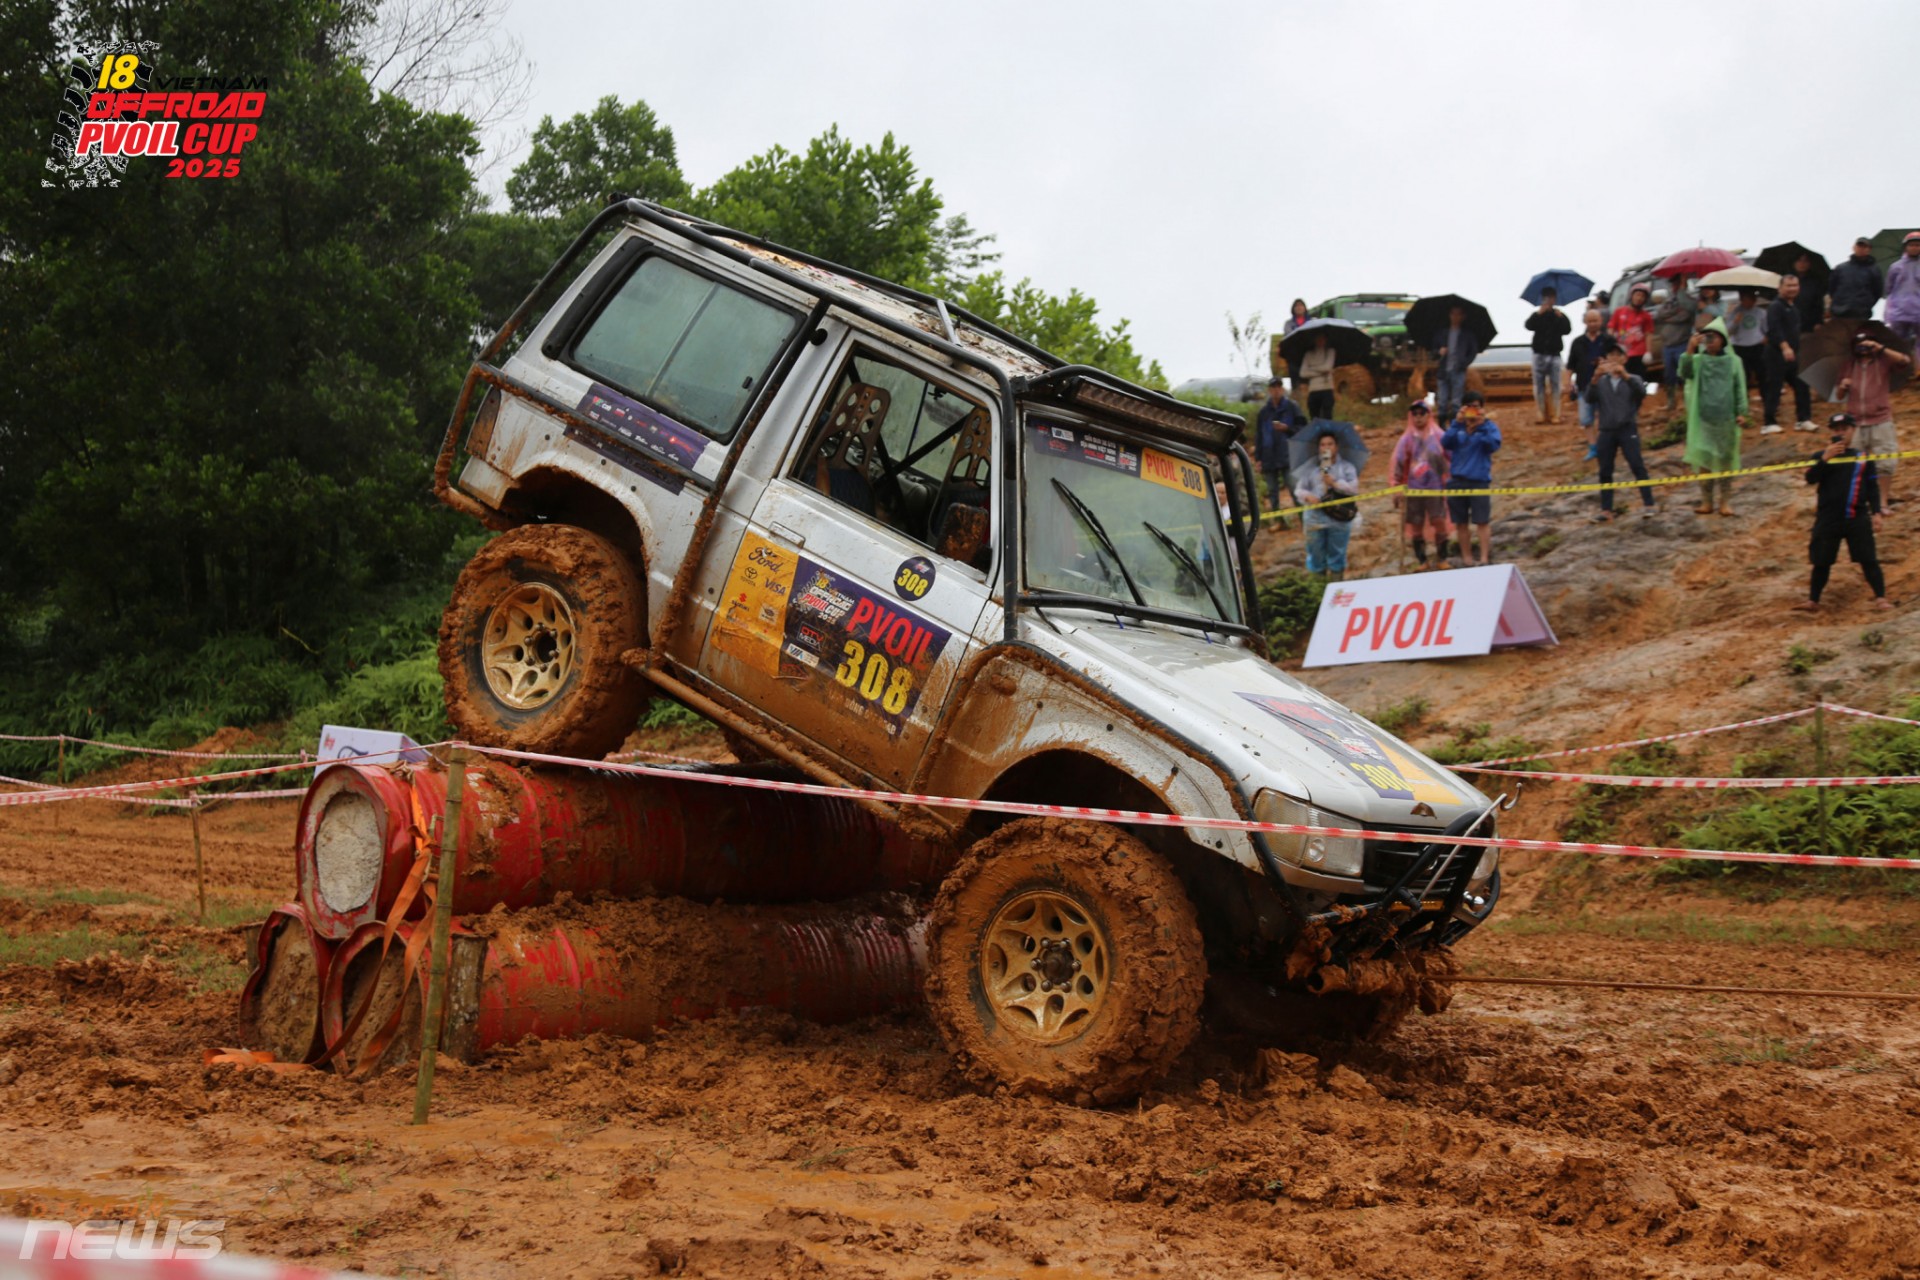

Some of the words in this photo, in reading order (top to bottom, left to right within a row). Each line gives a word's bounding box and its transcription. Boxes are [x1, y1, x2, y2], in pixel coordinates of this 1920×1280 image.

[1145, 453, 1178, 482] PVOIL
[1180, 466, 1202, 492] 308
[748, 546, 782, 573] Ford
[764, 578, 787, 597] VISA
[896, 568, 928, 597] 308
[847, 597, 934, 671] PVOIL
[1338, 598, 1455, 653] PVOIL
[835, 640, 914, 715] 308
